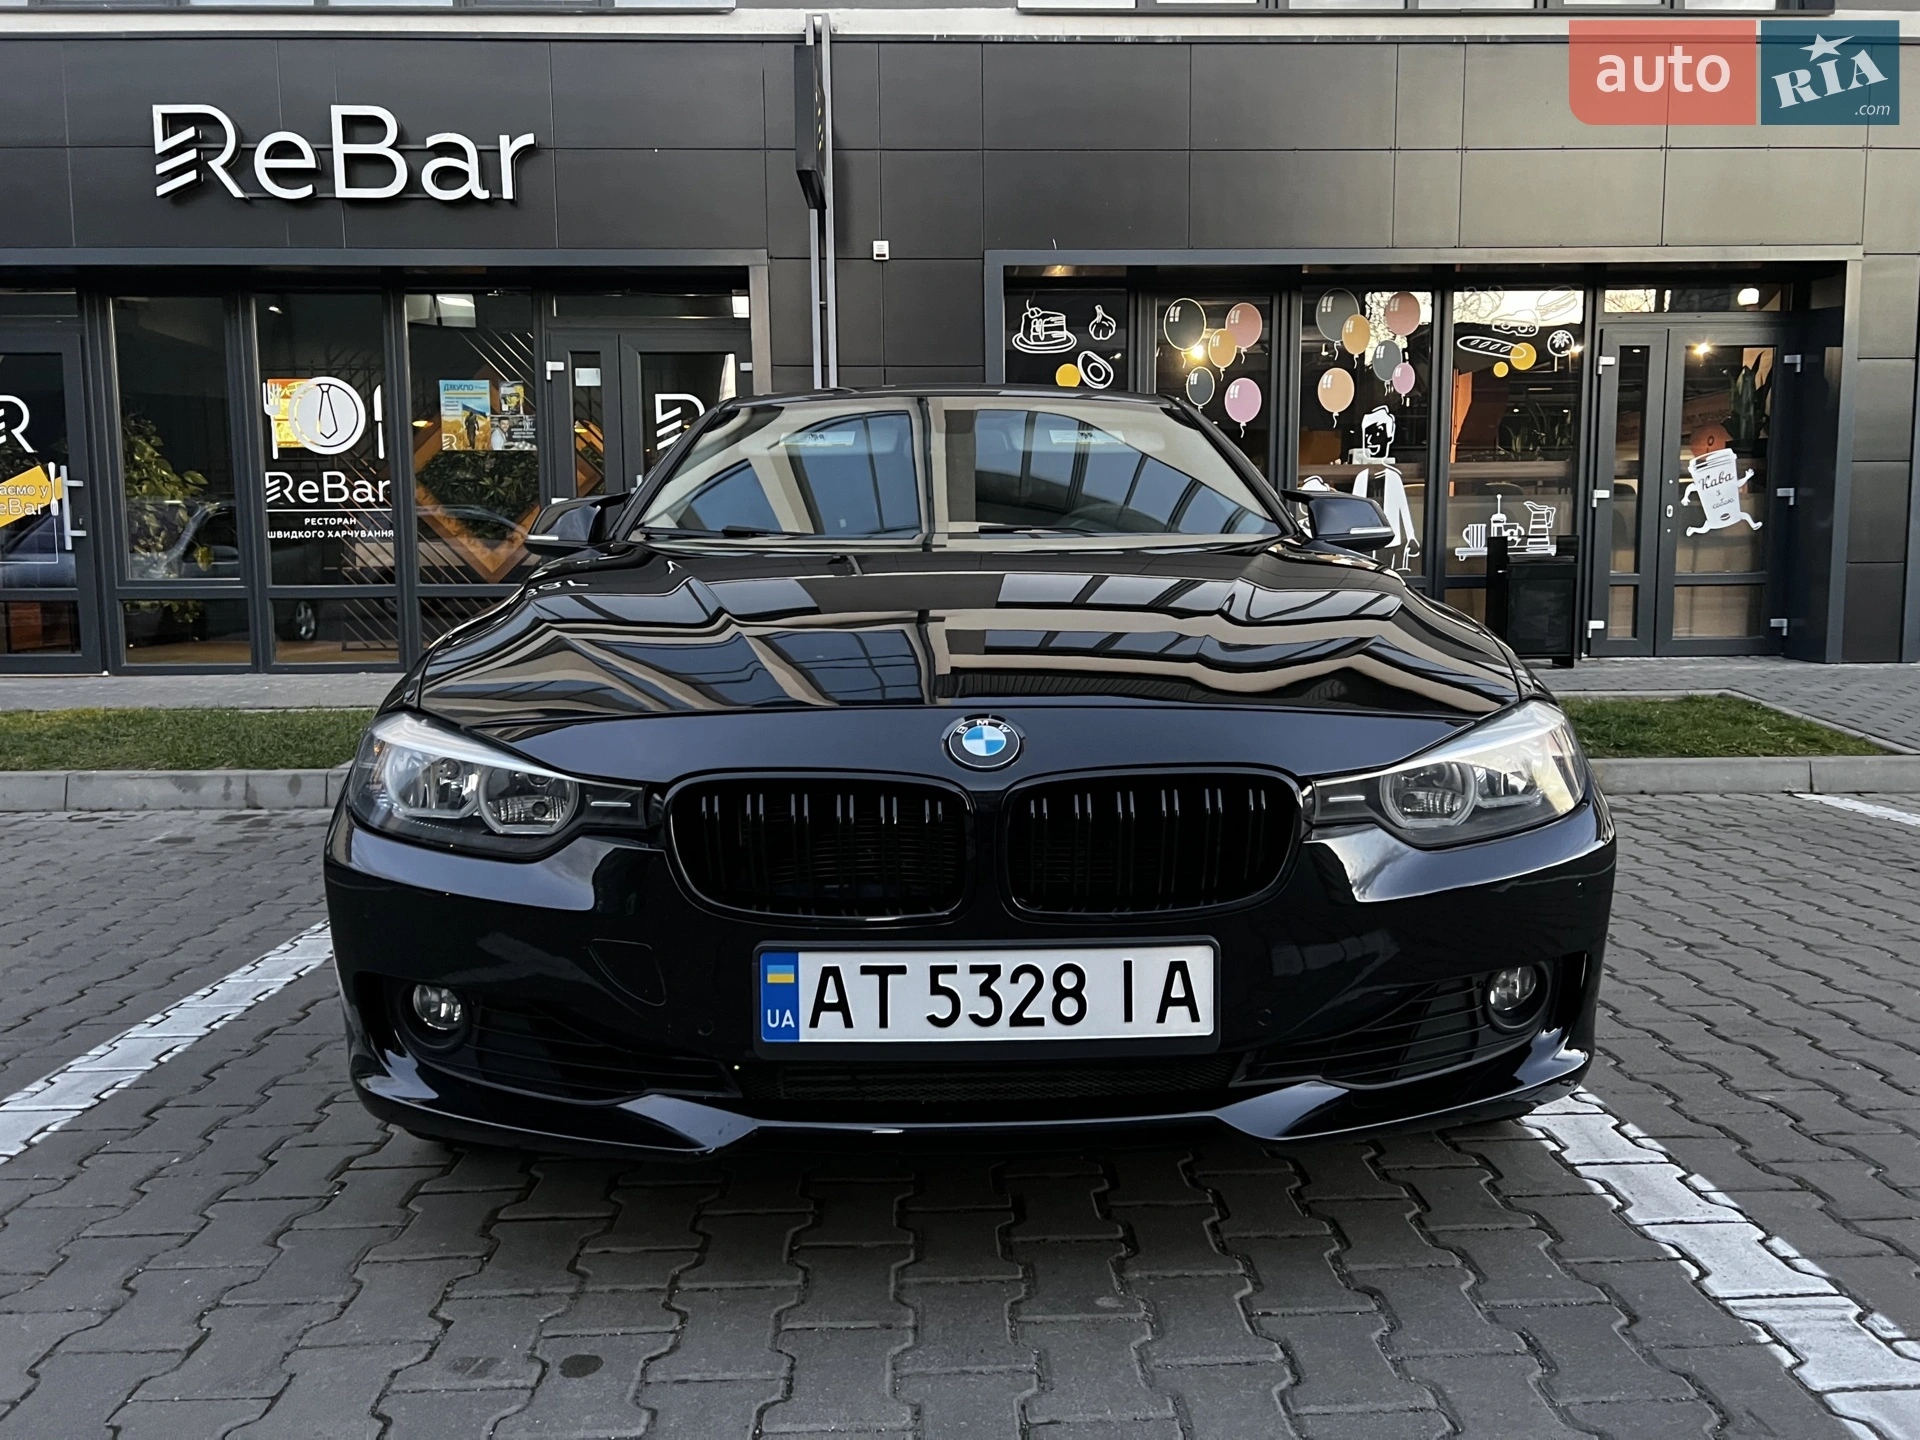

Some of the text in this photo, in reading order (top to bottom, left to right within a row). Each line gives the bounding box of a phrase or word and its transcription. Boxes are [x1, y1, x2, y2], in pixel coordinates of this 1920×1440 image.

[152, 104, 537, 201] ReBar
[265, 471, 391, 503] ReBar
[1700, 471, 1735, 490] Кава
[304, 518, 357, 526] РЕСТОРАН
[267, 530, 394, 539] ШВИДКОГО ХАРЧУВАННЯ
[956, 720, 1011, 734] BMW
[808, 959, 1201, 1029] AT 5328 IA
[767, 1009, 795, 1029] UA
